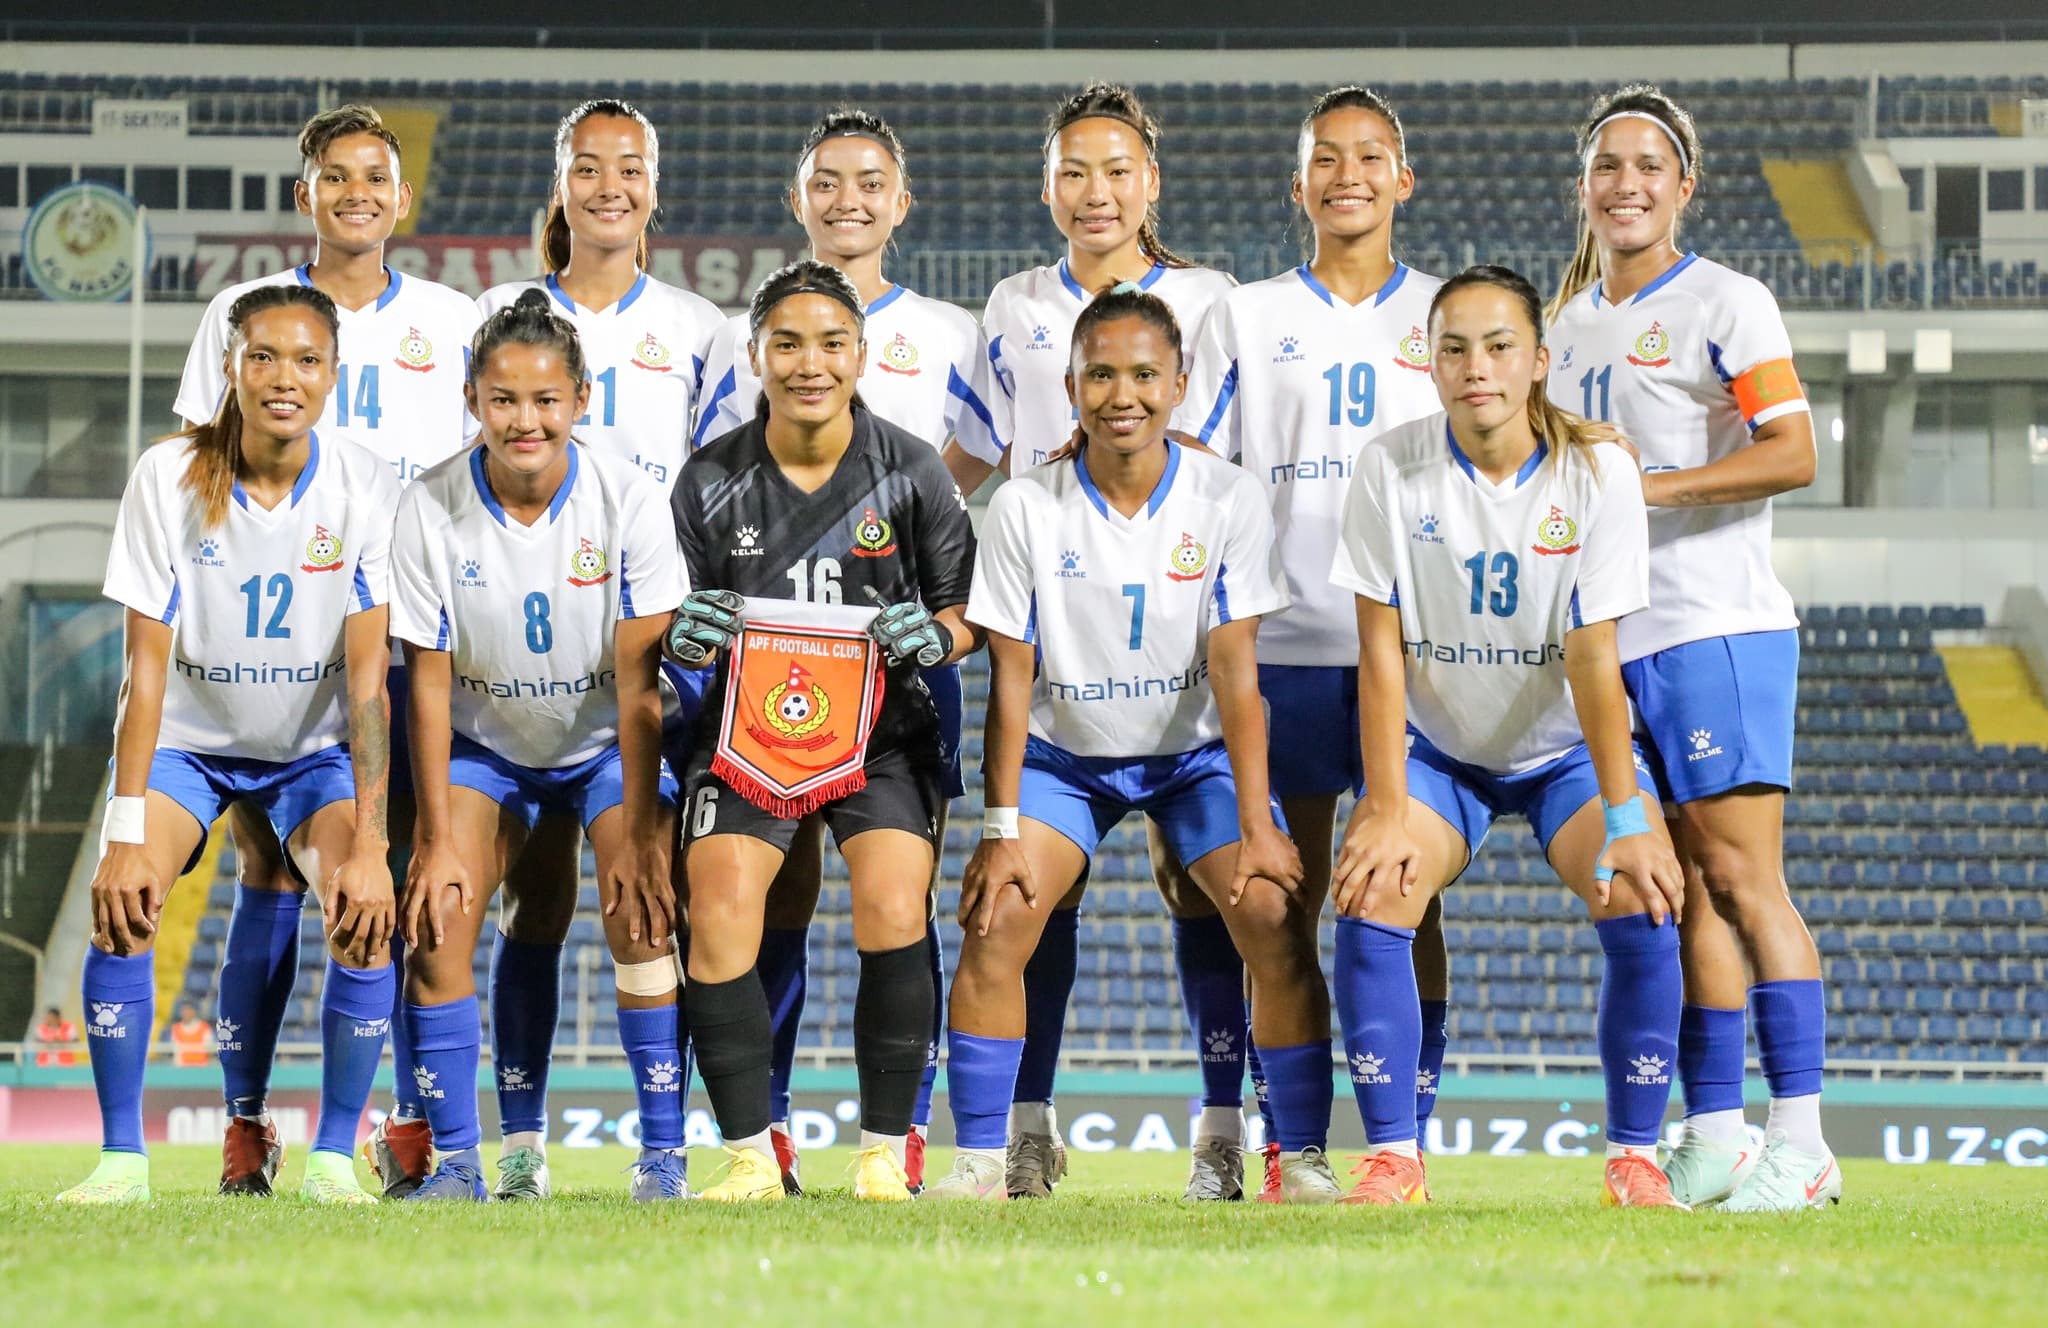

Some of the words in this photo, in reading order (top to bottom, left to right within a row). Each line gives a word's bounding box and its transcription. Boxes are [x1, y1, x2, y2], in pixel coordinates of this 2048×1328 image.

[1273, 354, 1306, 363] KELME
[337, 364, 382, 429] 14
[1323, 362, 1376, 427] 19
[1580, 364, 1612, 422] 11
[1412, 533, 1445, 544] KELME
[731, 548, 764, 556] KELME
[192, 557, 225, 567] KELME
[786, 557, 843, 604] 16
[1055, 570, 1086, 578] KELME
[1465, 551, 1519, 617] 13
[240, 573, 294, 639] 12
[523, 591, 553, 654] 8
[1122, 584, 1146, 650] 7
[748, 635, 770, 649] APF
[772, 637, 829, 657] FOOTBALL
[832, 642, 862, 659] CLUB
[460, 670, 615, 698] mahindr
[1688, 746, 1723, 762] KELME
[87, 1024, 126, 1038] KELME
[1203, 1053, 1239, 1062] KELME
[1352, 1074, 1392, 1084] KELME
[1626, 1075, 1669, 1085] KELME
[643, 1083, 680, 1092] KELME
